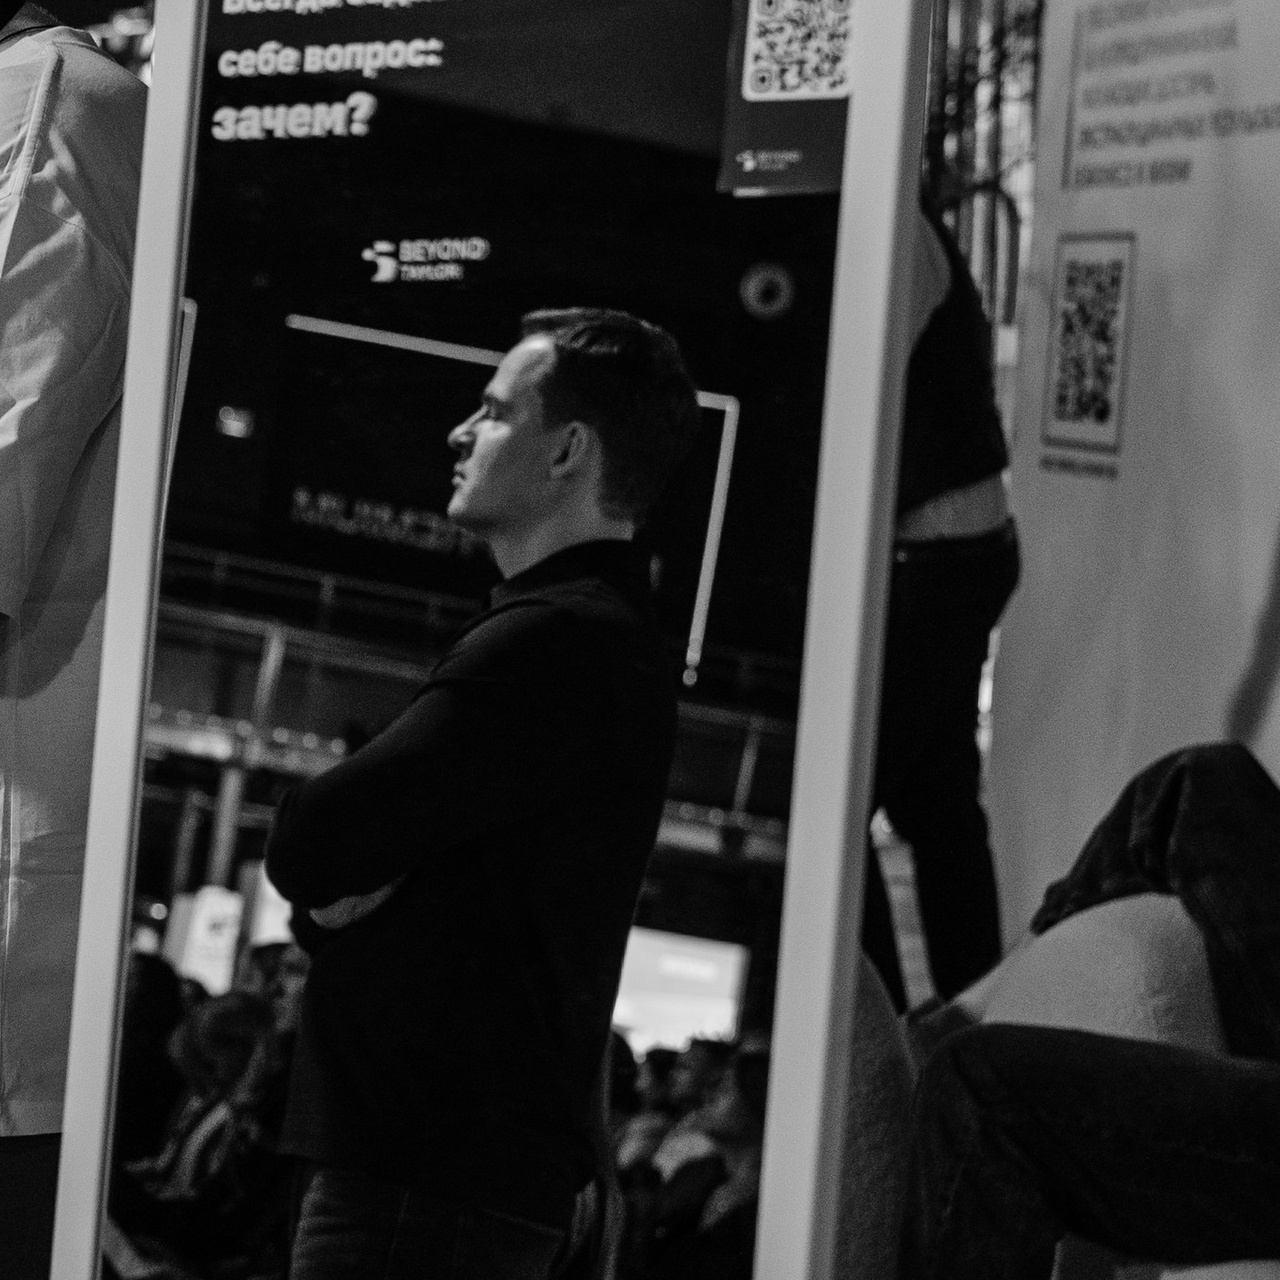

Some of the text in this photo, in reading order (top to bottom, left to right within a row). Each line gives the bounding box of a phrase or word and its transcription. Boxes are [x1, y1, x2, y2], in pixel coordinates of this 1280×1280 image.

[218, 37, 444, 79] себе вопрос:
[211, 91, 378, 141] зачем?
[399, 236, 490, 262] BEYOND
